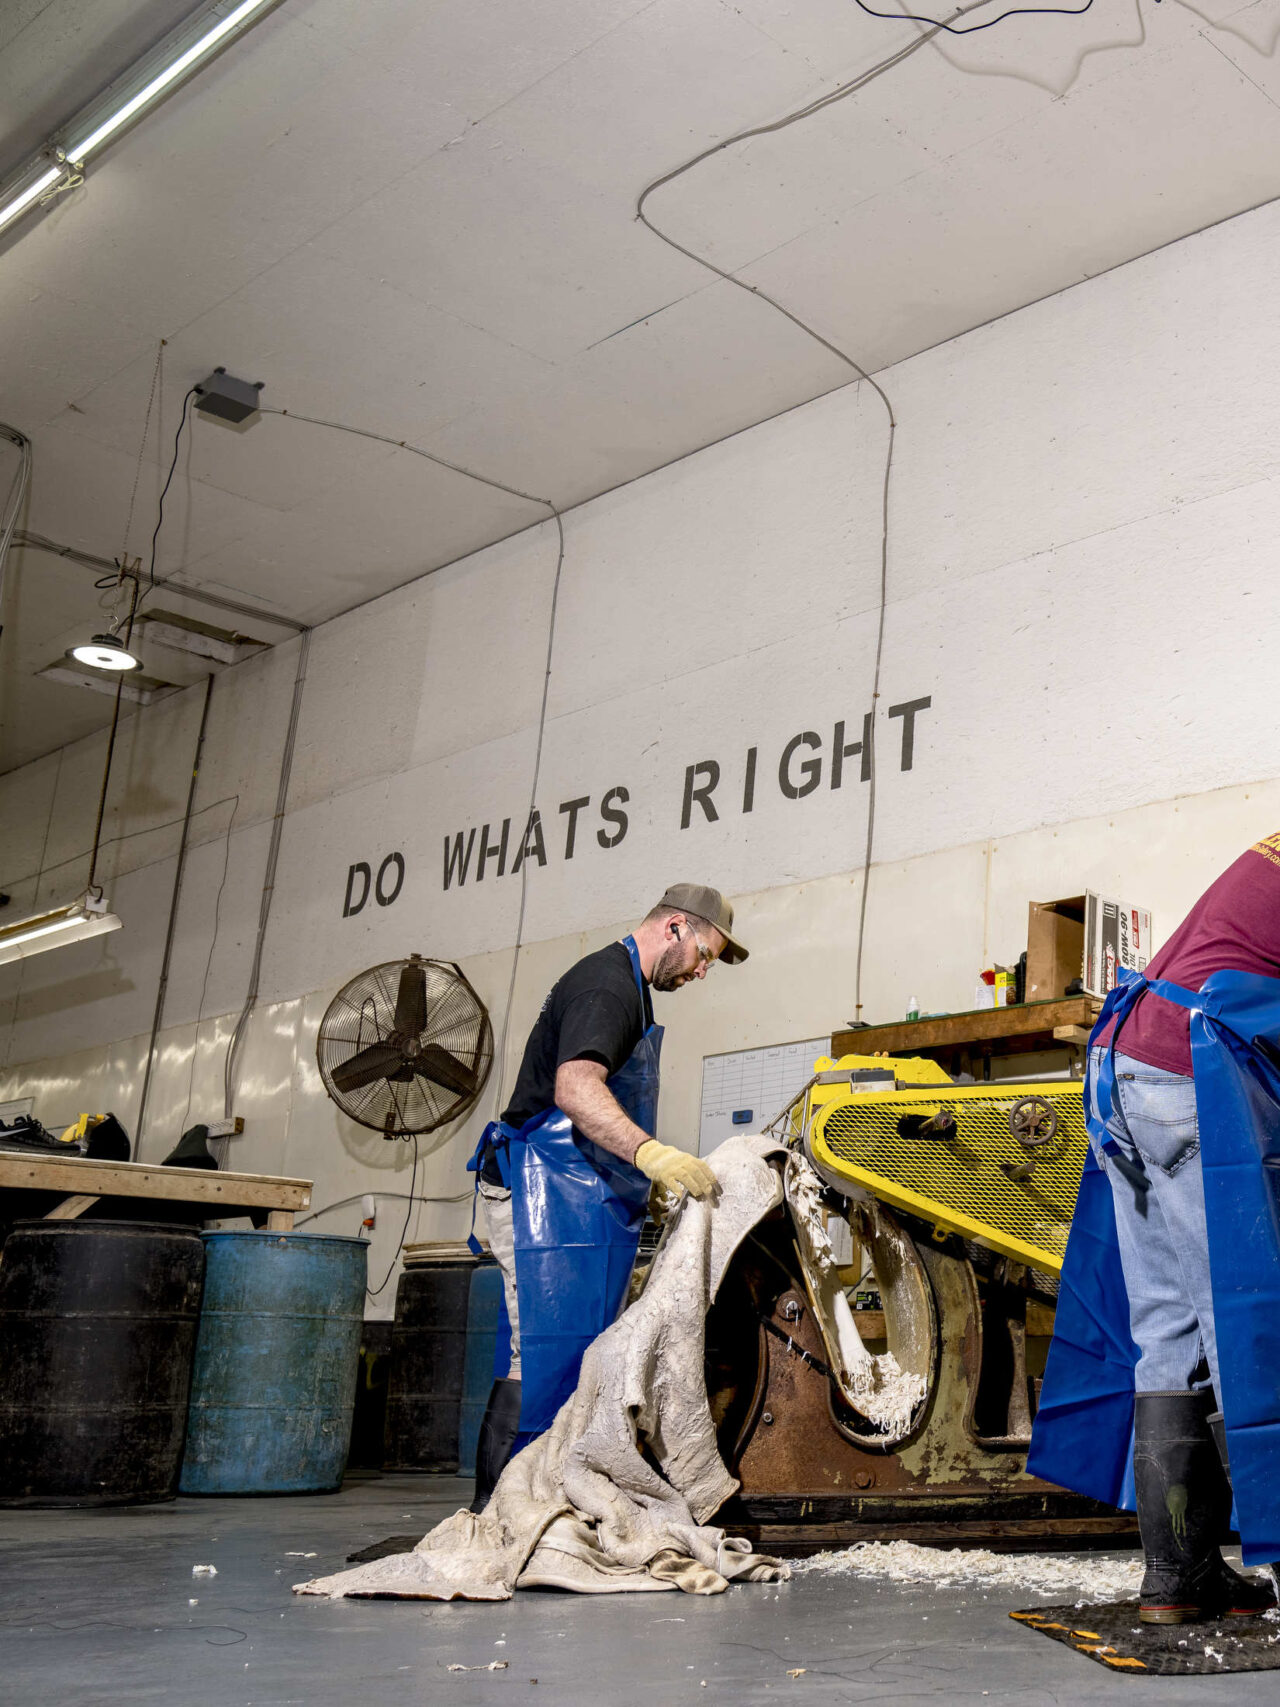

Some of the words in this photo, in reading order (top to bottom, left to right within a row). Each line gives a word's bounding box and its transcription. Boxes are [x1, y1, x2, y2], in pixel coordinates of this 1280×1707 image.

[342, 851, 405, 918] DO
[443, 786, 630, 890] WHATS
[680, 696, 932, 830] RIGHT
[1120, 911, 1129, 965] 80W-90
